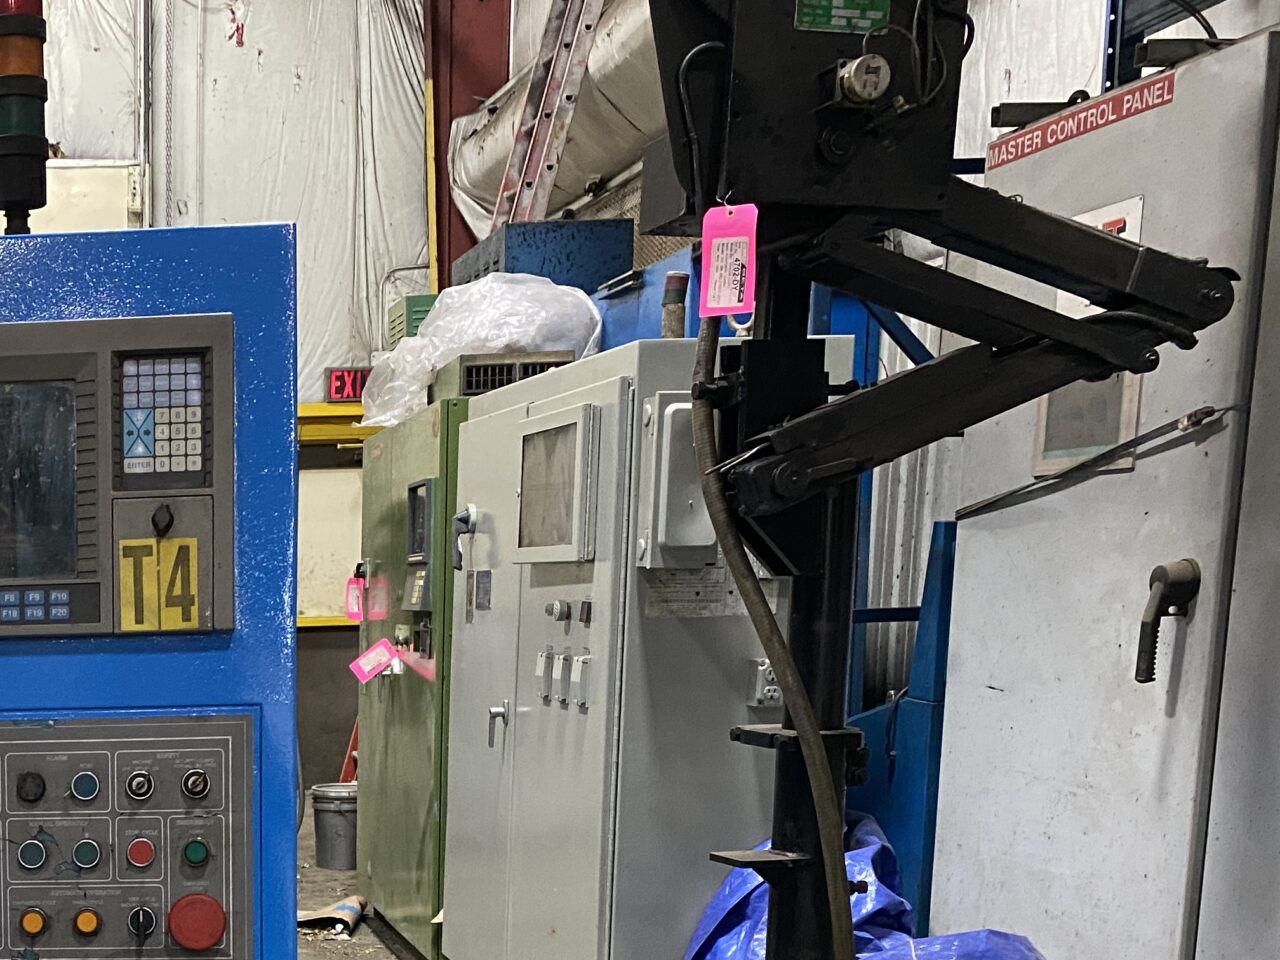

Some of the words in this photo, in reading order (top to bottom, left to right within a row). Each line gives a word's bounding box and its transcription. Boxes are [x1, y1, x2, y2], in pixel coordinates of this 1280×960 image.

[988, 130, 1042, 167] MASTER
[1047, 101, 1117, 143] CONTROL
[1122, 81, 1172, 115] PANEL
[330, 370, 369, 399] EXI
[122, 544, 196, 625] T4
